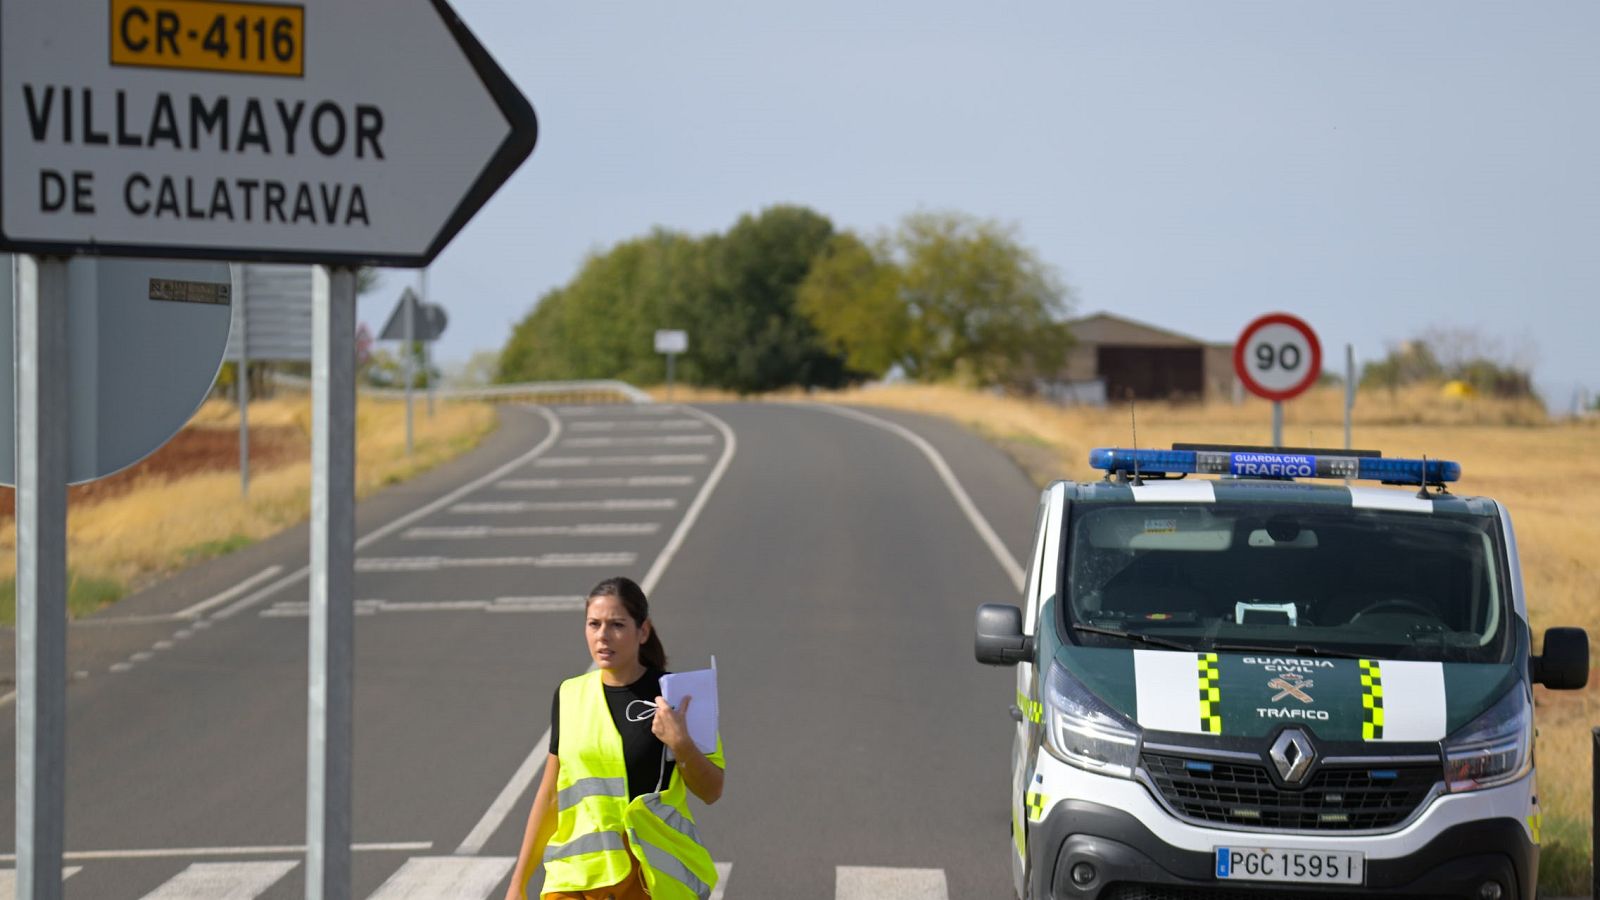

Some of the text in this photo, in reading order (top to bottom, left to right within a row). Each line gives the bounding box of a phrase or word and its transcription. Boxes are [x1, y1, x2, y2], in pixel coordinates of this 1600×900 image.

[119, 7, 294, 62] CR-4116
[22, 83, 386, 159] VILLAMAYOR
[39, 169, 370, 226] DE CALATRAVA
[1256, 342, 1300, 371] 90
[1235, 454, 1310, 464] GUARDIA CIVIL
[1242, 657, 1335, 668] GUARDIA
[1264, 665, 1314, 673] CIVIL
